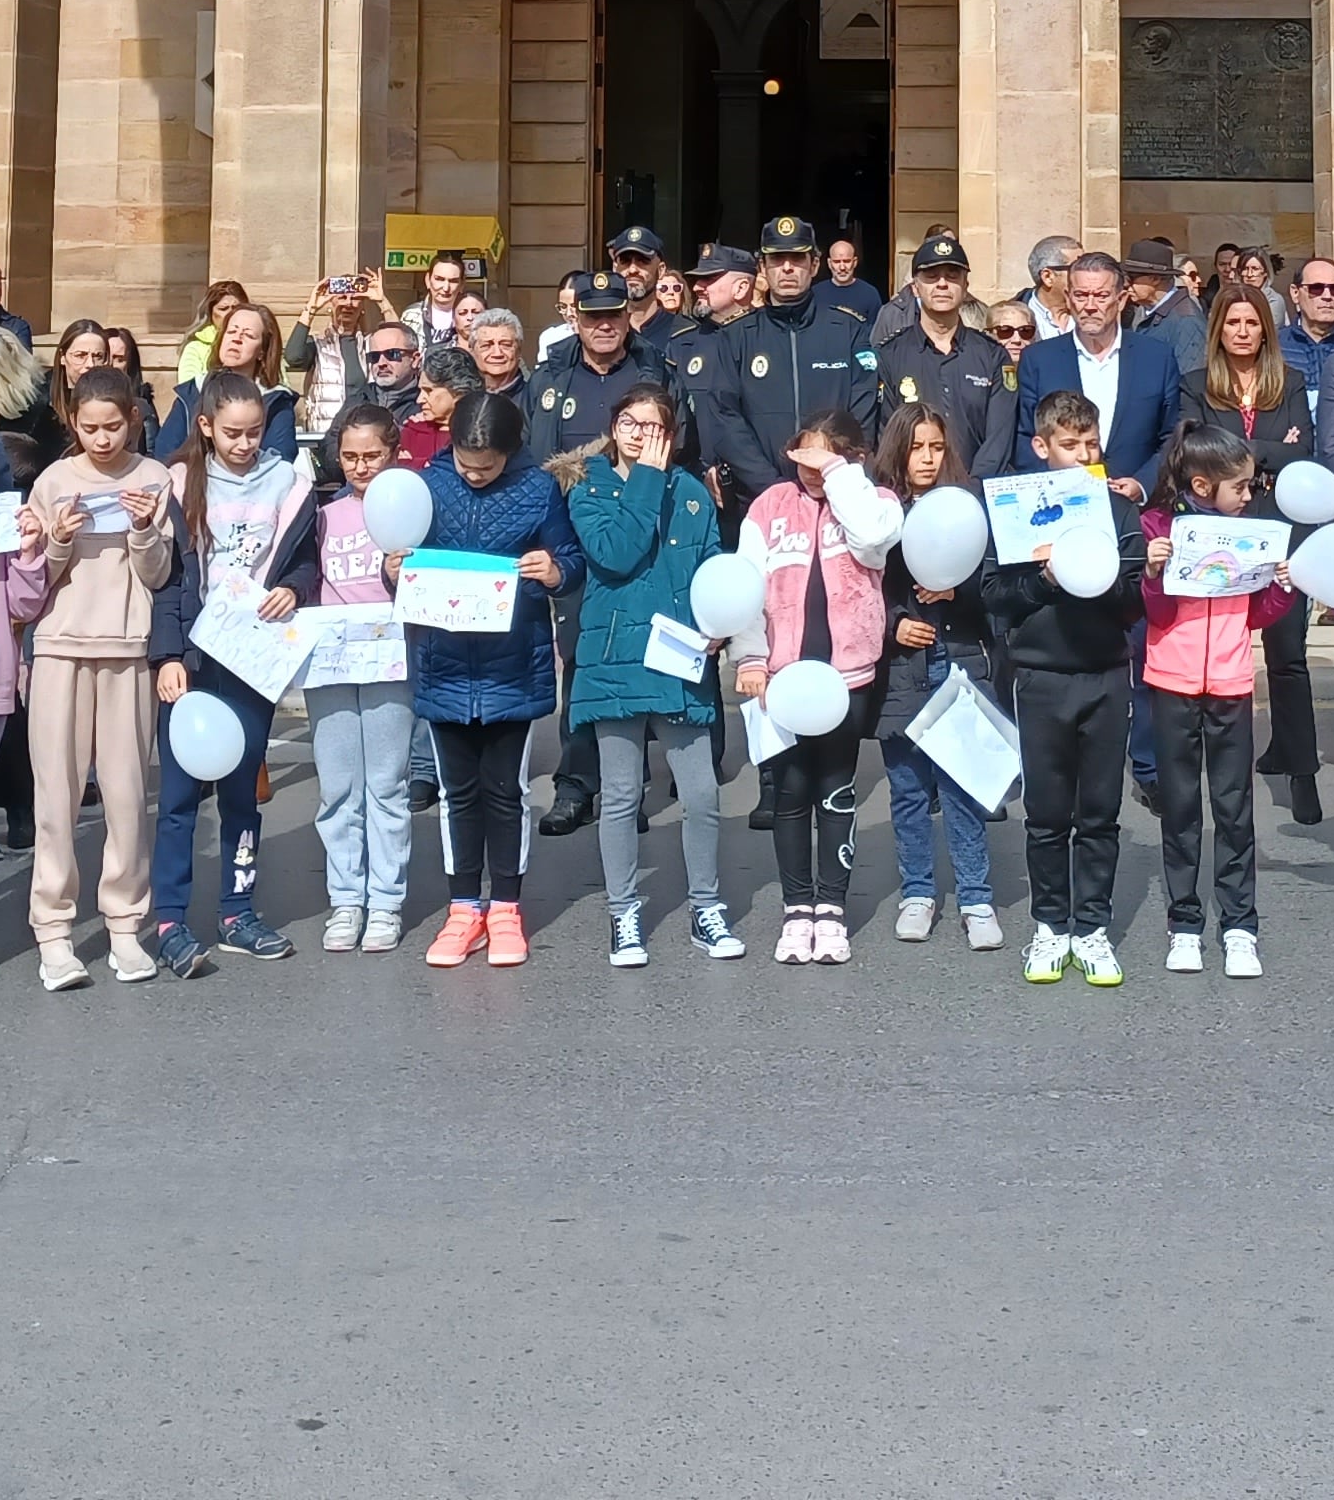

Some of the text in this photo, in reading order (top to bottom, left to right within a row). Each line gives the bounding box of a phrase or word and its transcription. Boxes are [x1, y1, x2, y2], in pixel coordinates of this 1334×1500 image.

[407, 255, 431, 266] ON
[326, 529, 373, 554] KEE
[326, 549, 383, 581] REA
